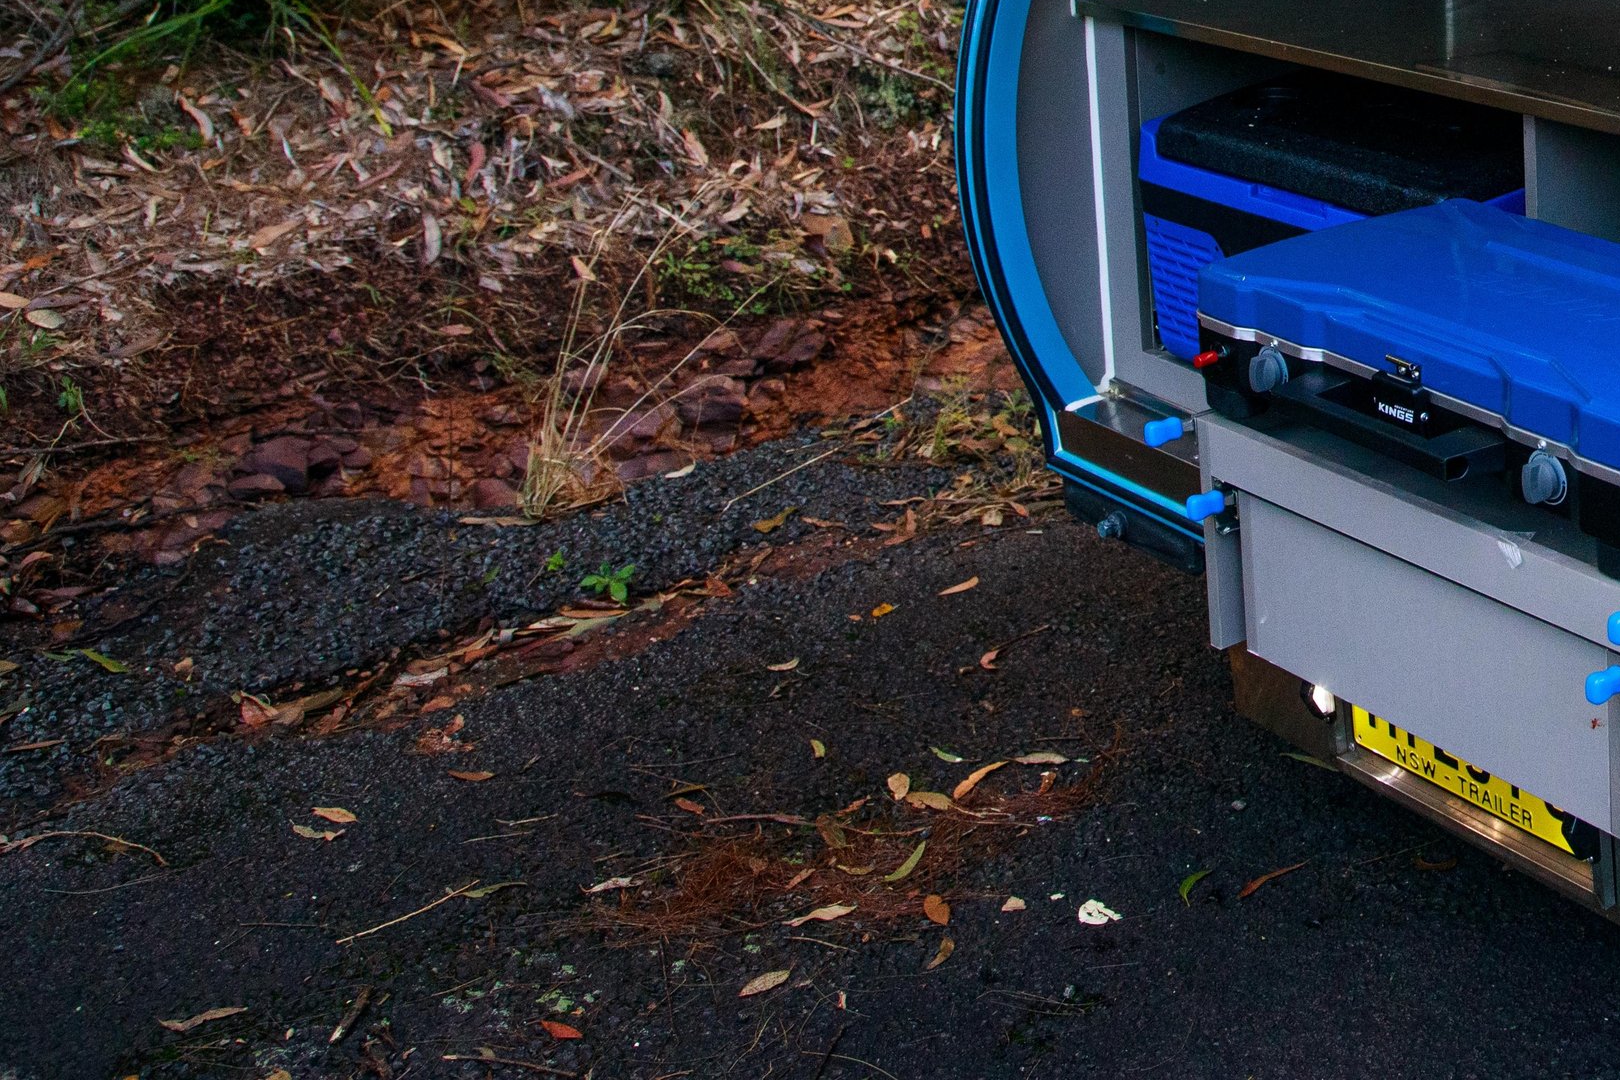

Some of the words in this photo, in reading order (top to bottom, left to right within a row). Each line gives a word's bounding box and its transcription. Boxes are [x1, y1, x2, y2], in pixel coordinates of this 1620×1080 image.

[1378, 401, 1414, 423] KINGS
[1396, 744, 1436, 778] NSW
[1457, 775, 1533, 829] TRAILER
